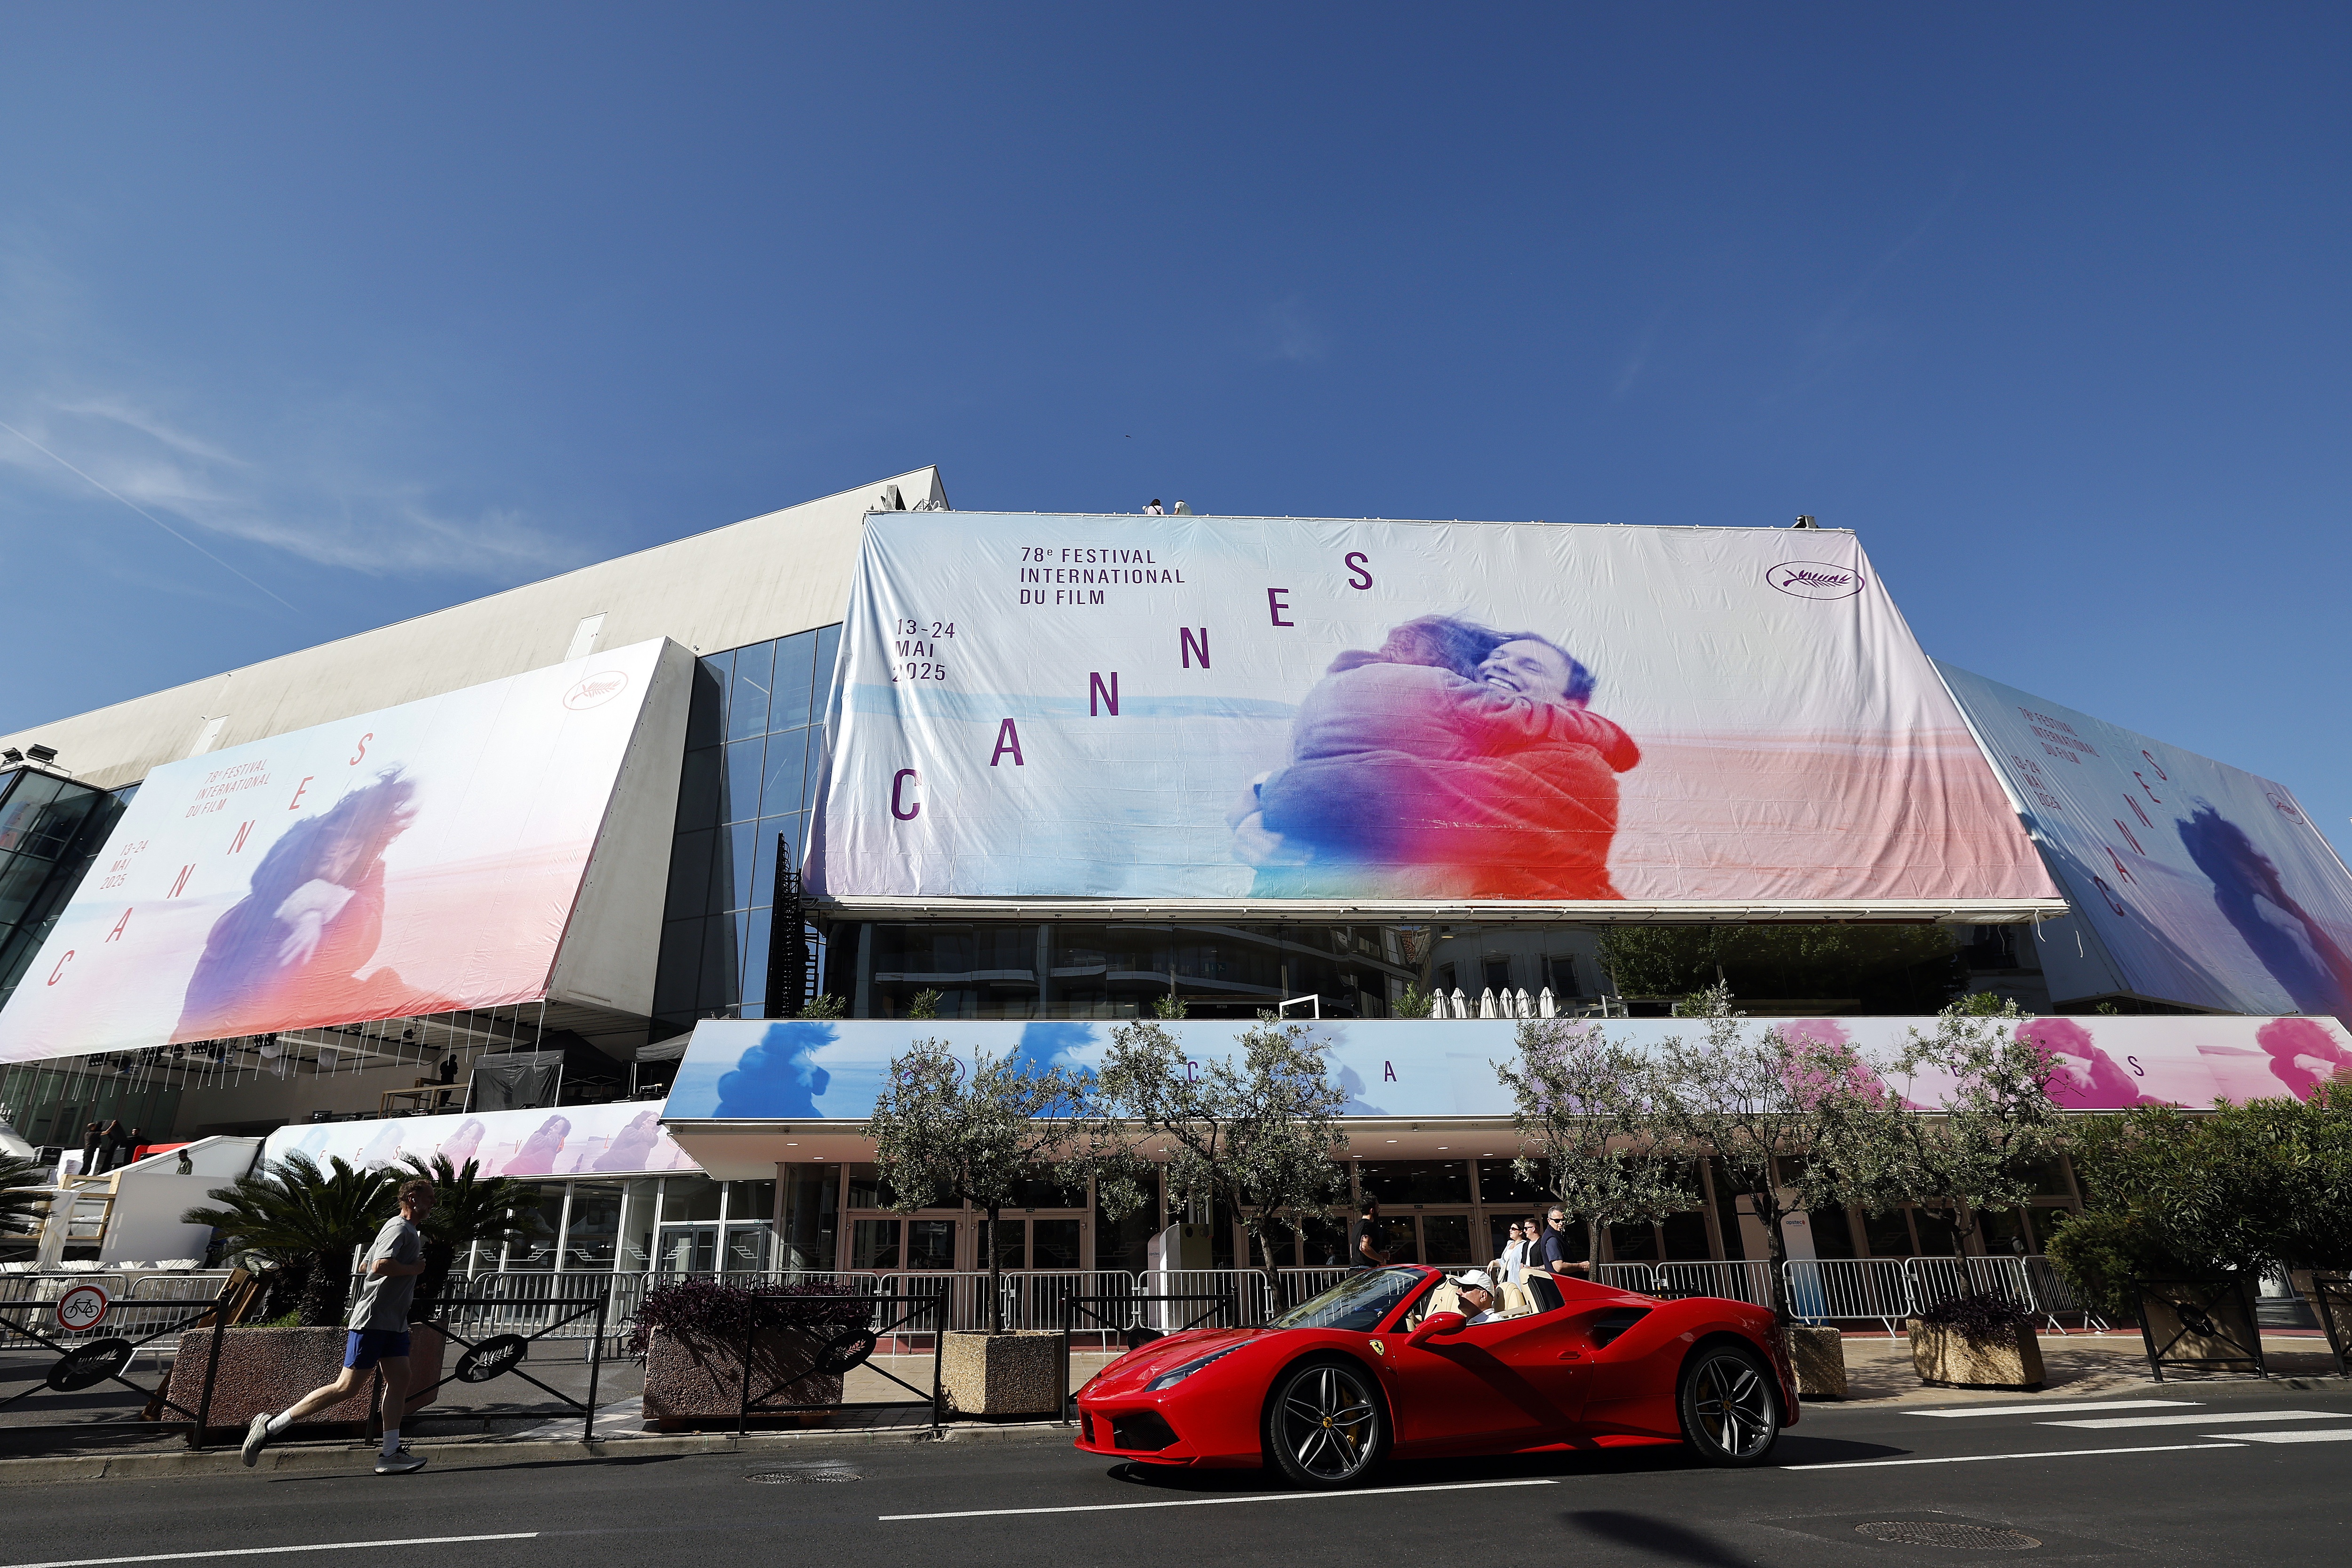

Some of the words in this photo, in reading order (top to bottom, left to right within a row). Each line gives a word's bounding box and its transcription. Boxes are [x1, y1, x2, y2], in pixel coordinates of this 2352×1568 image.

[1062, 549, 1156, 564] FESTIVAL
[1021, 568, 1184, 583] INTERNATIONAL
[1020, 589, 1045, 605] DU
[1057, 590, 1104, 605] FILM
[897, 619, 955, 638] 13-24
[895, 640, 934, 658] MAI
[892, 662, 946, 682] 2025
[2034, 713, 2078, 737] FESTIVAL
[2029, 724, 2100, 757] INTERNATIONAL
[2041, 741, 2058, 757] DU
[2055, 747, 2081, 764] FILM
[222, 759, 268, 780] FESTIVAL
[2011, 755, 2042, 775] 13-24
[194, 773, 271, 801] INTERNATIONAL
[2022, 772, 2045, 790] MAI
[185, 804, 202, 818] DU
[201, 798, 227, 814] FILM
[2034, 791, 2062, 810] 2025
[120, 840, 149, 856] 13-24
[110, 858, 132, 873] MAI
[99, 874, 127, 890] 2025
